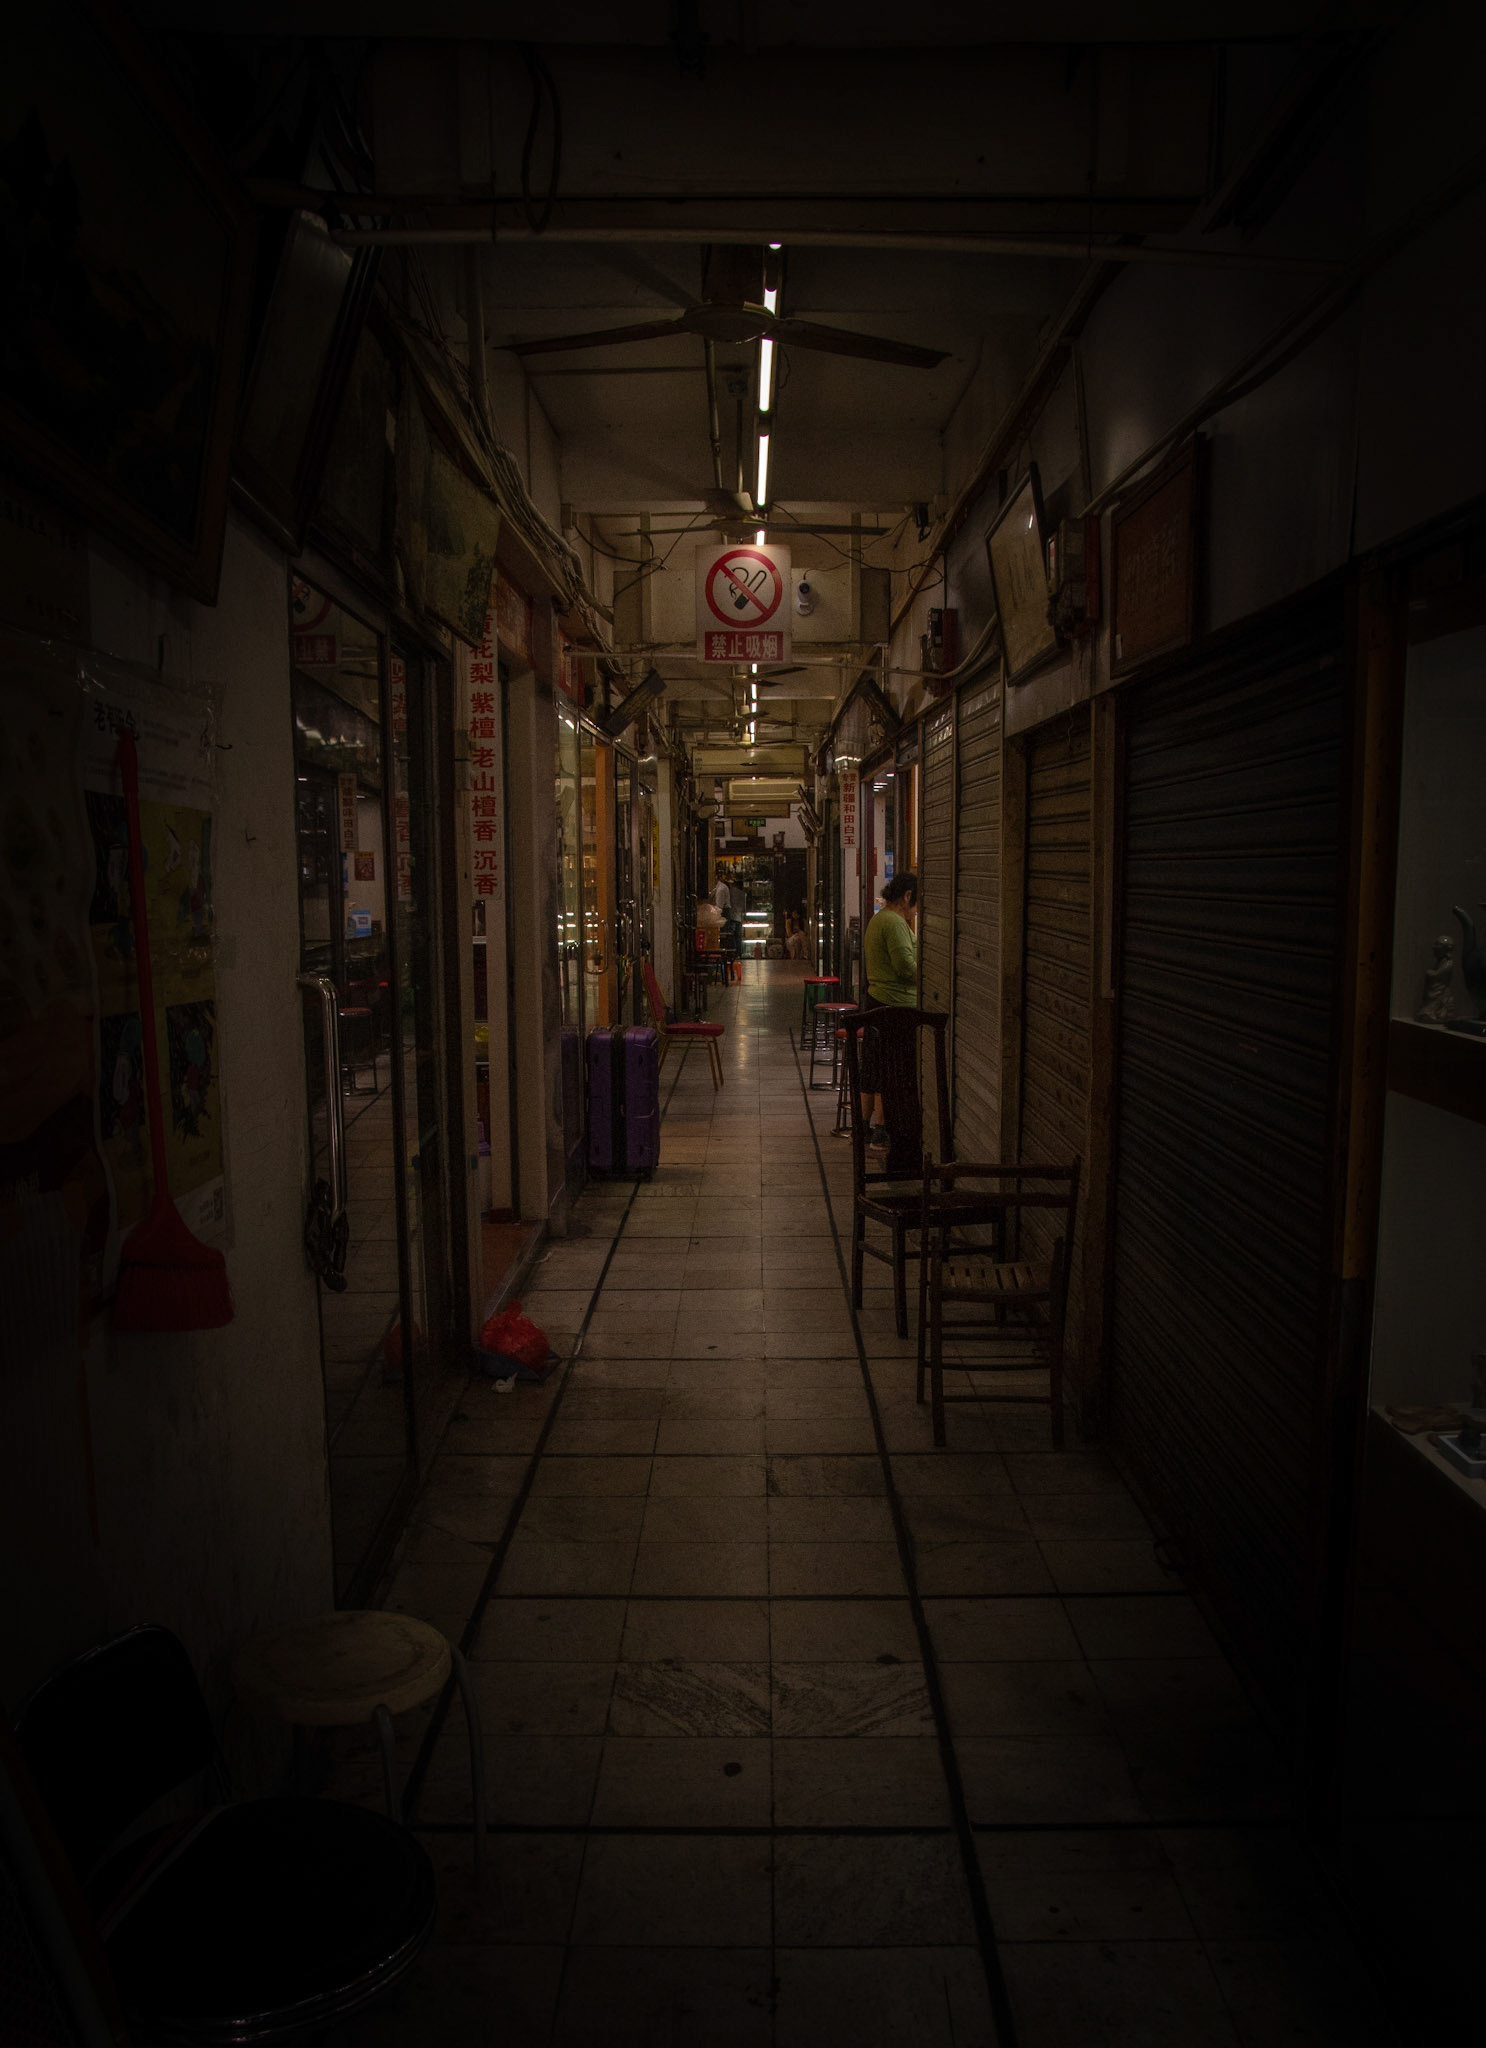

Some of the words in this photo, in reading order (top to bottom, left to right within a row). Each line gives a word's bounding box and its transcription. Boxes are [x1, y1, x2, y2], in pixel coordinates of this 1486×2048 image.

[711, 634, 779, 659] 禁止吸烟
[470, 691, 495, 739] 紫檀
[472, 747, 497, 842] 老山檀香
[843, 782, 856, 846] 新疆和田白玉
[474, 850, 498, 896] 沉香
